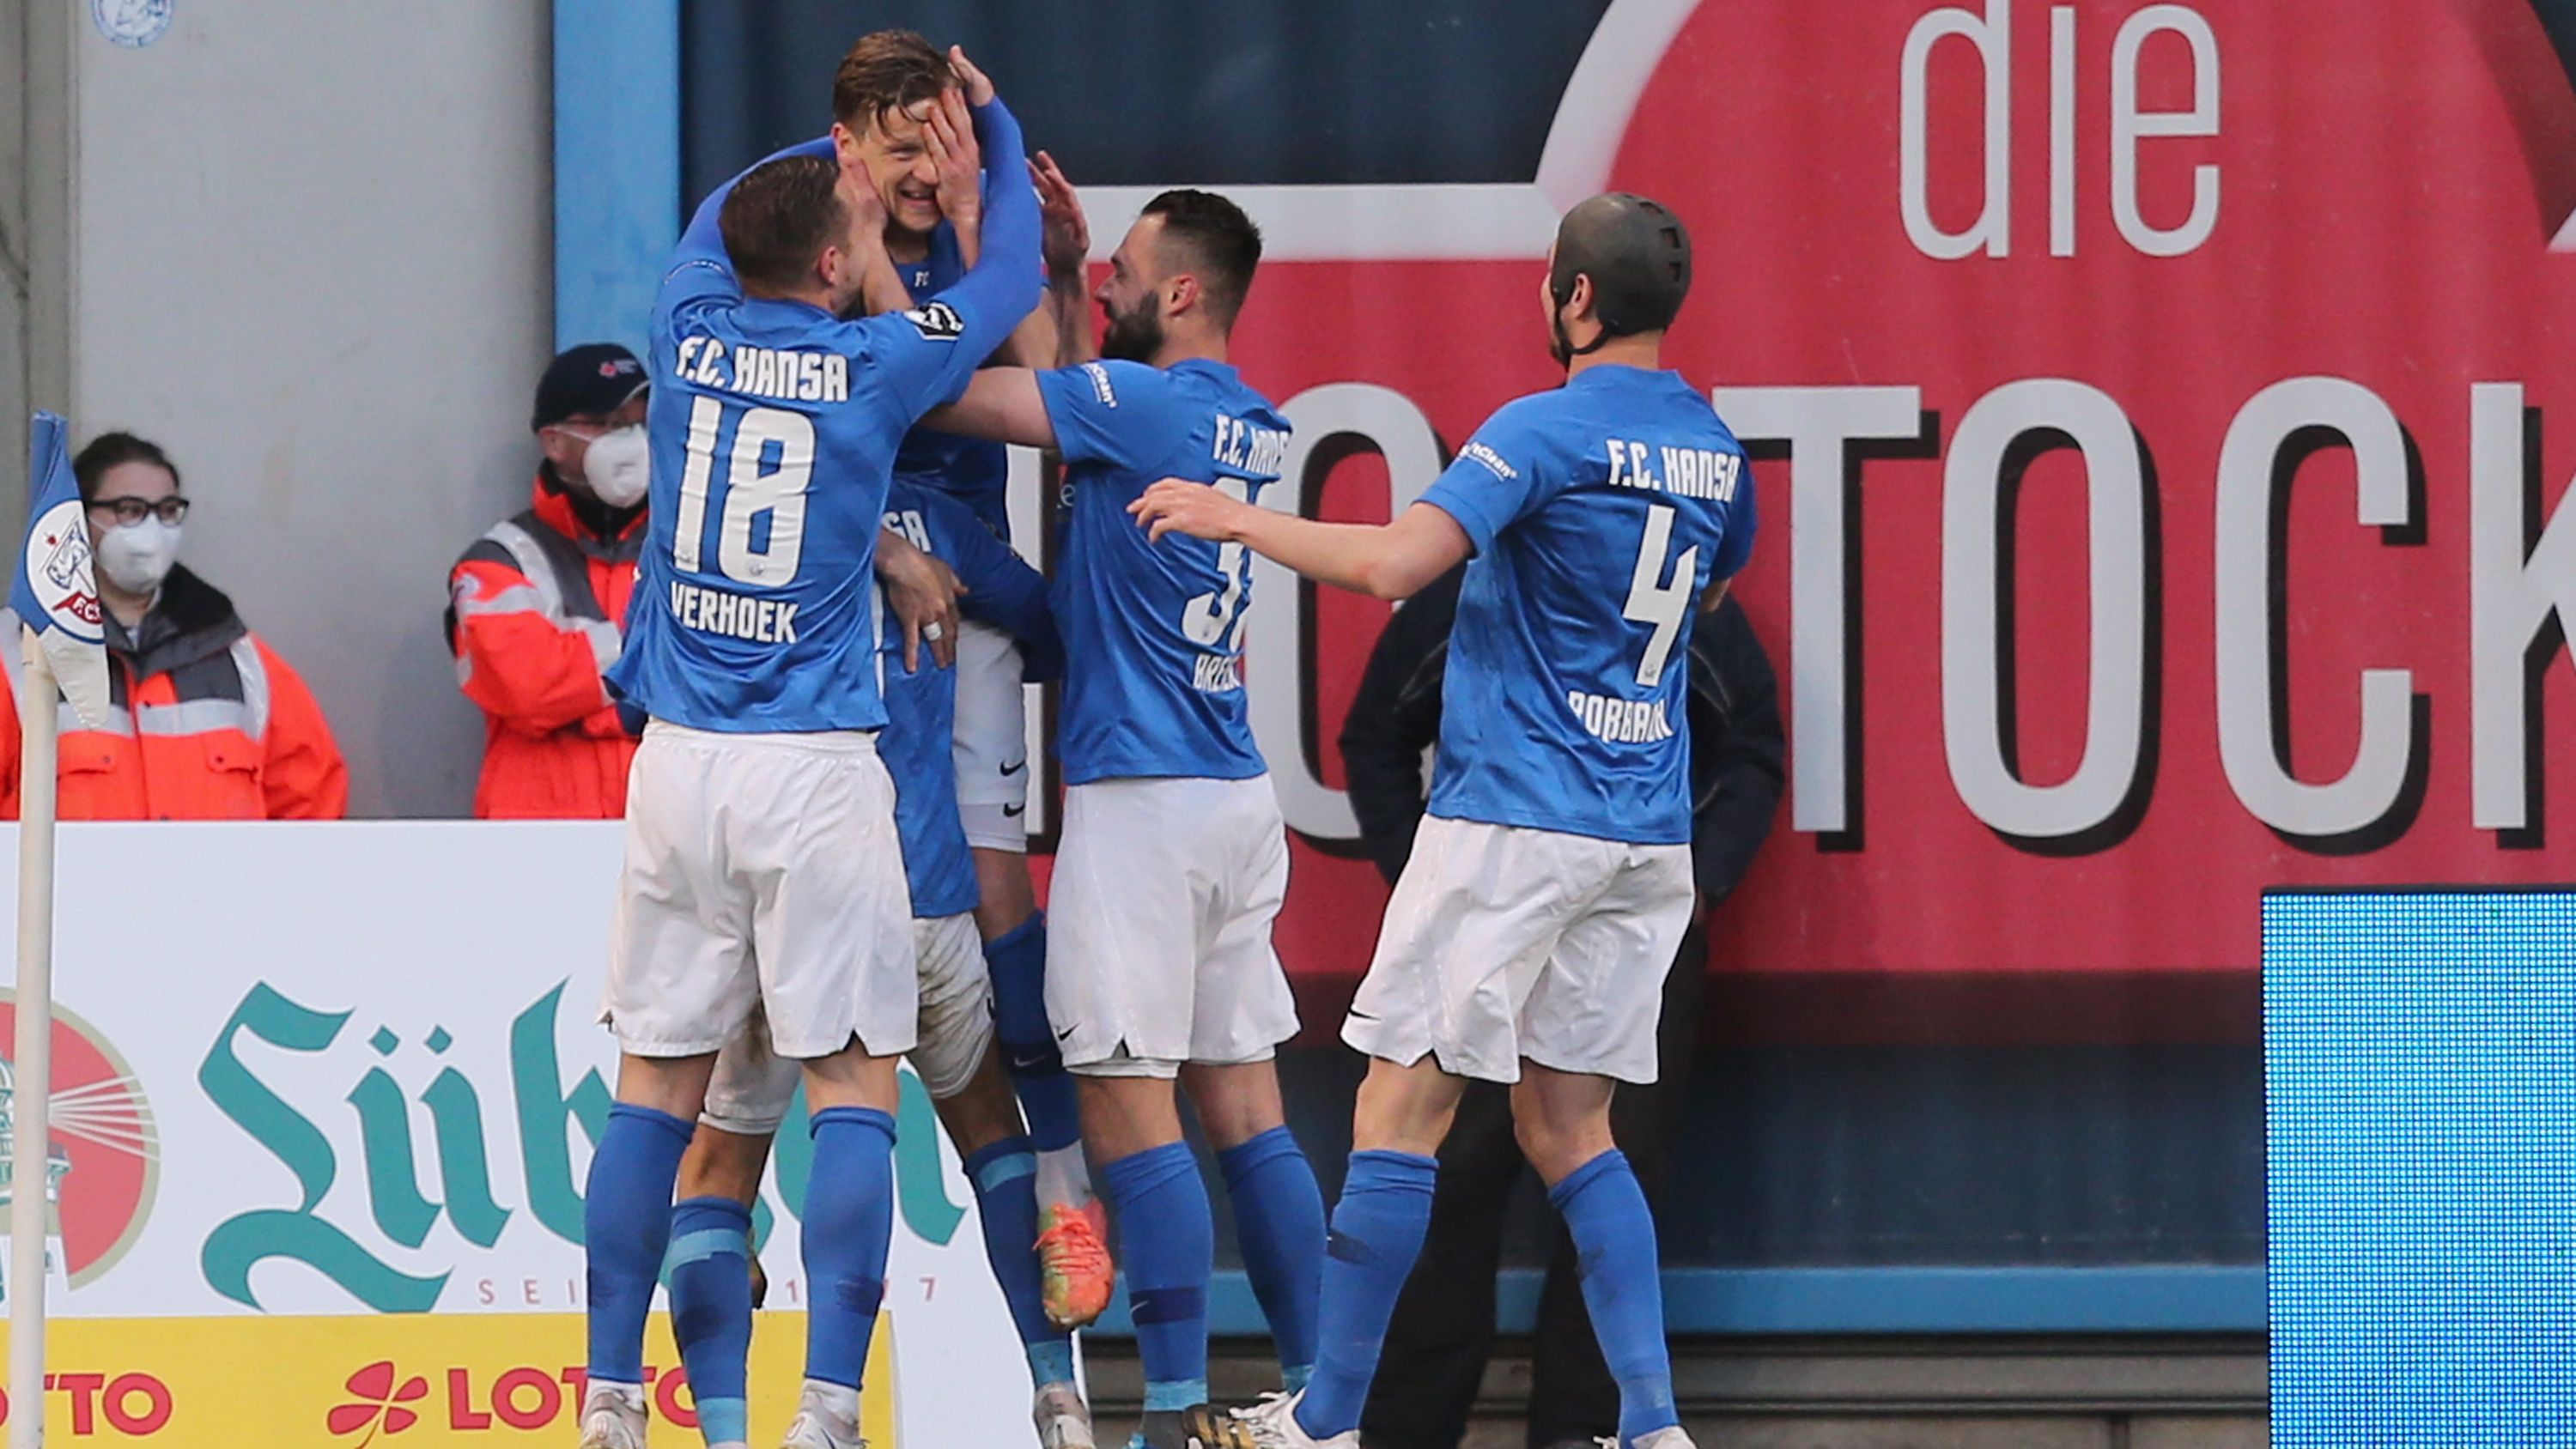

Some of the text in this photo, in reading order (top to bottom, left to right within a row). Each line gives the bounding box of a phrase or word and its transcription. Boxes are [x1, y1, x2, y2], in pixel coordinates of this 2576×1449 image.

[1896, 0, 2221, 260] die
[676, 336, 848, 402] F.C. HANSA
[673, 395, 816, 588] 18
[1606, 440, 1741, 503] F.C. HANSA
[671, 580, 799, 644] VERHOEK
[1622, 504, 1698, 687] 4
[477, 1280, 574, 1304] SEI
[0, 1373, 172, 1435] TO
